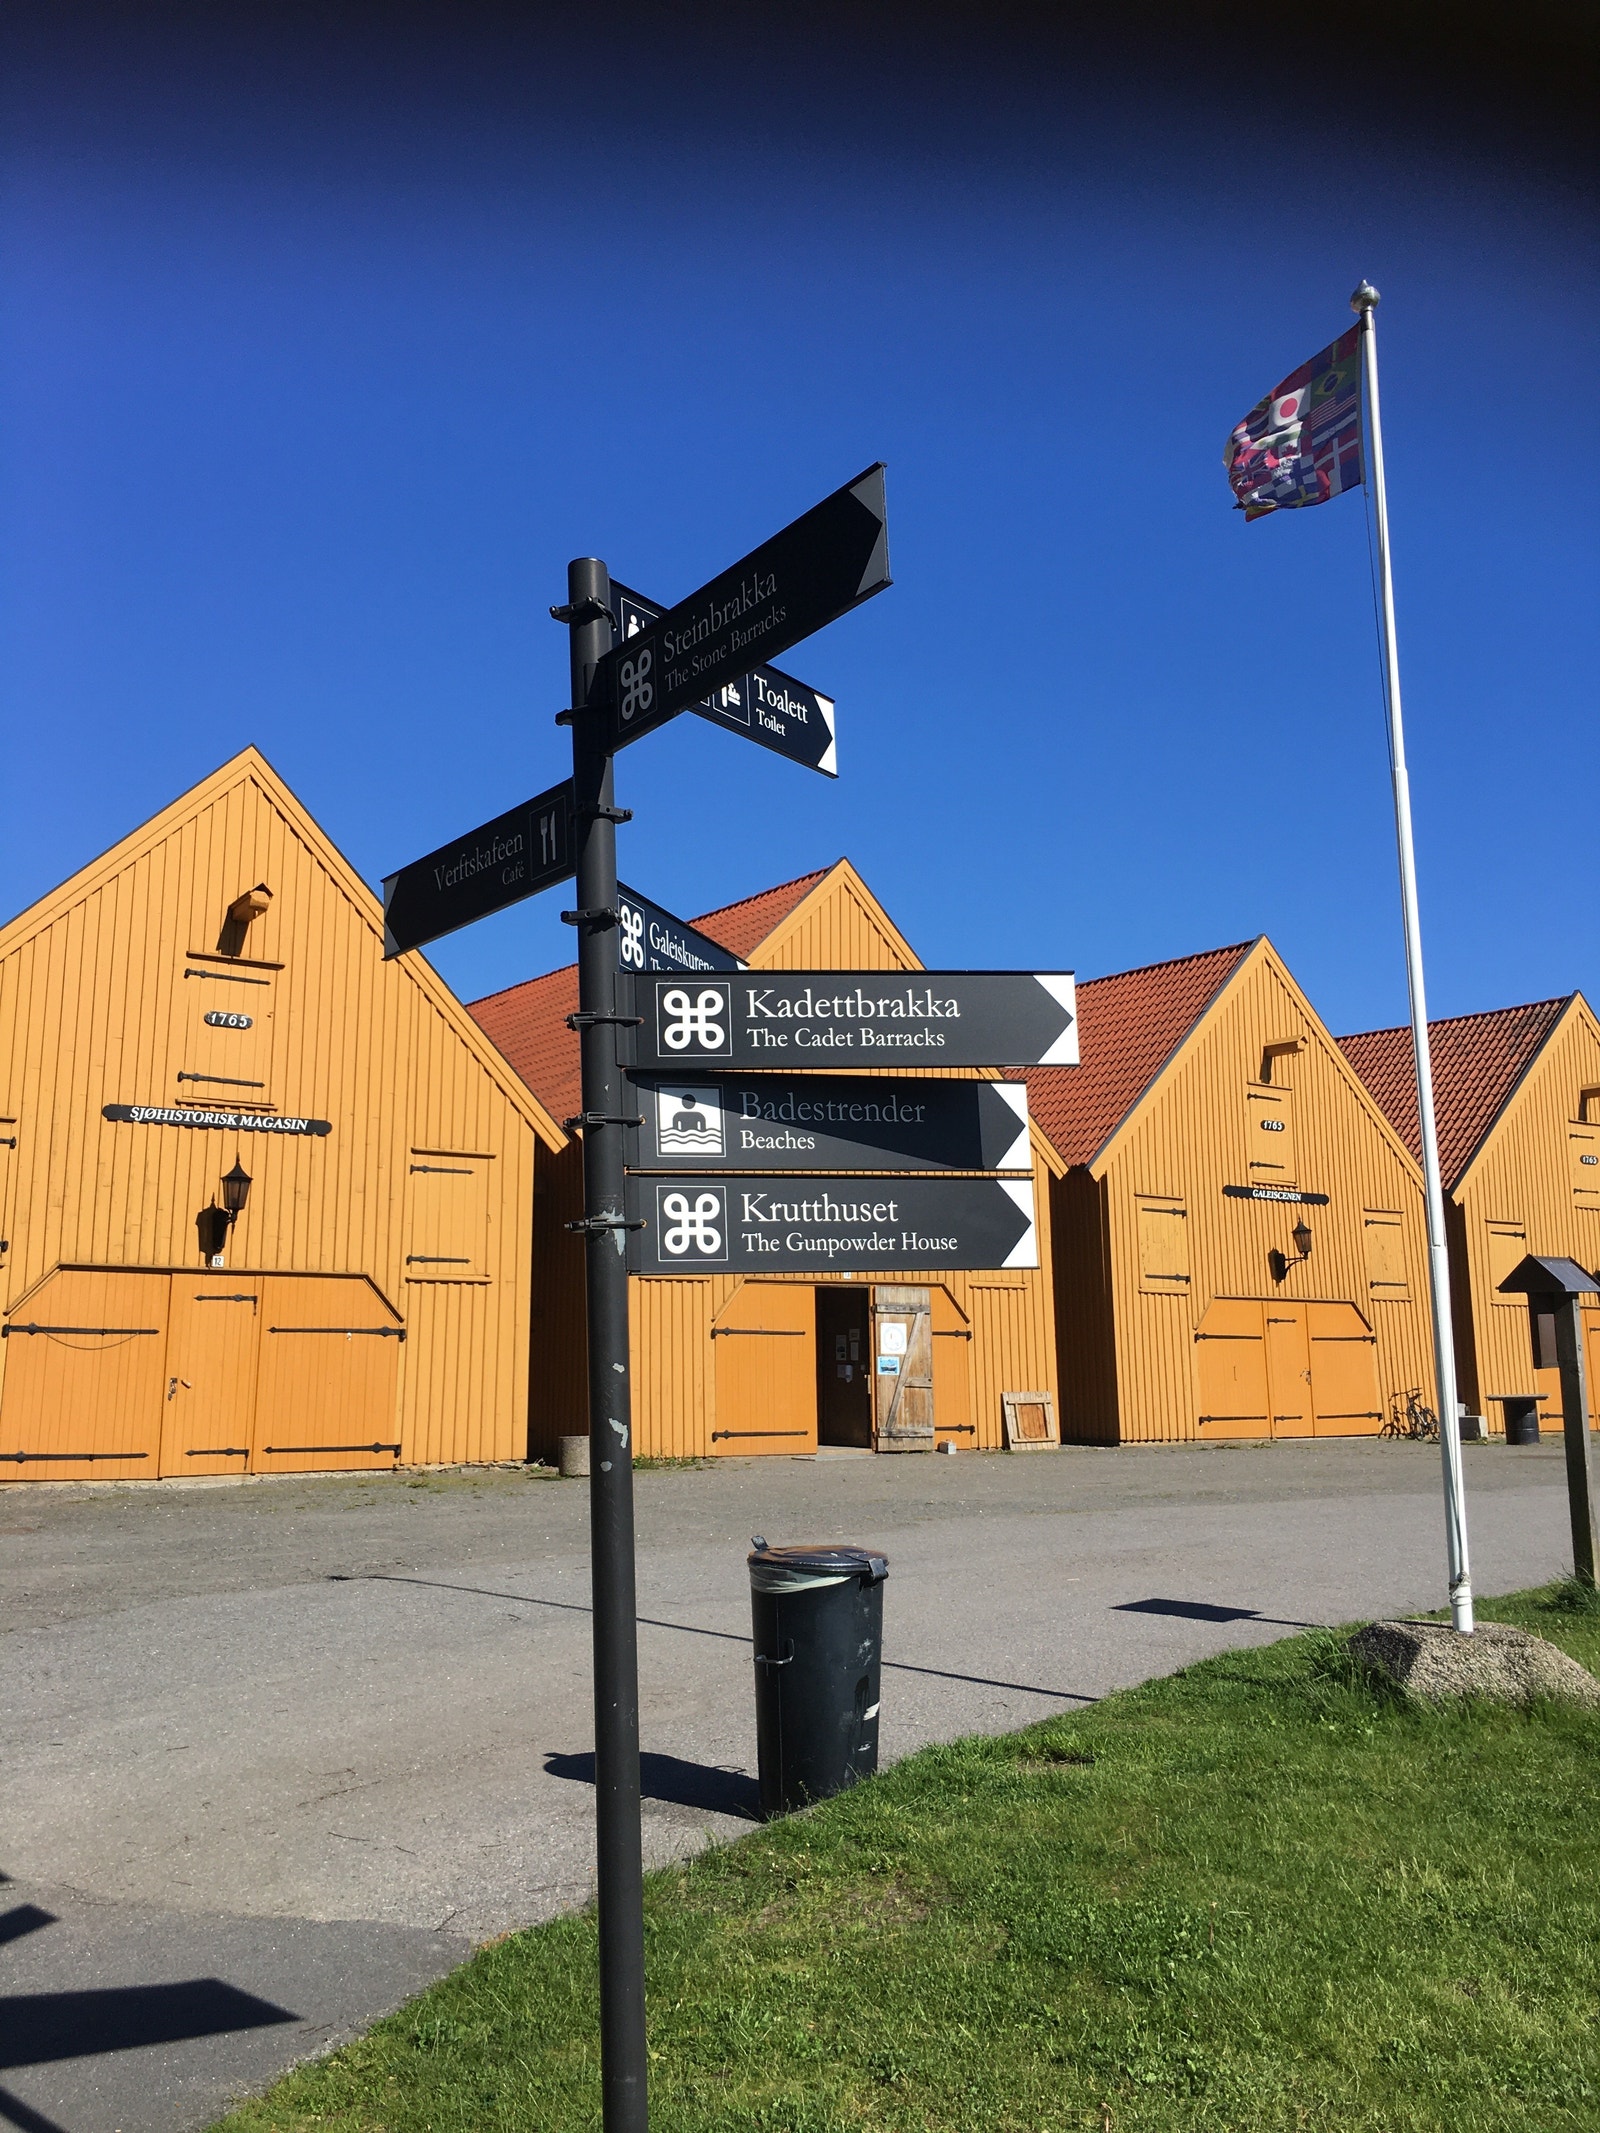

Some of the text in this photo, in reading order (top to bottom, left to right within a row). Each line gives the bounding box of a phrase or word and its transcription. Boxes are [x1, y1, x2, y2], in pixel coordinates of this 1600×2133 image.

[664, 572, 777, 663] Steinbrakka
[665, 605, 787, 692] The Stone Barracks
[754, 674, 808, 724] Toalett
[756, 709, 786, 737] Toilet
[434, 834, 523, 891] Verftskafeen
[502, 861, 525, 885] Café
[746, 988, 961, 1018] Kadettbrakka
[211, 1012, 249, 1028] 1765
[747, 1027, 945, 1047] The Cadet Barracks
[129, 1106, 309, 1131] SJØHISTORISK MAGASIN
[738, 1091, 926, 1123] Badestrender
[1263, 1121, 1283, 1131] 1765
[740, 1130, 816, 1149] Beaches
[741, 1193, 899, 1222] Krutthuset
[1252, 1189, 1302, 1201] GALEISCENEN
[741, 1232, 958, 1258] The Gunpowder House
[214, 1257, 222, 1266] 12
